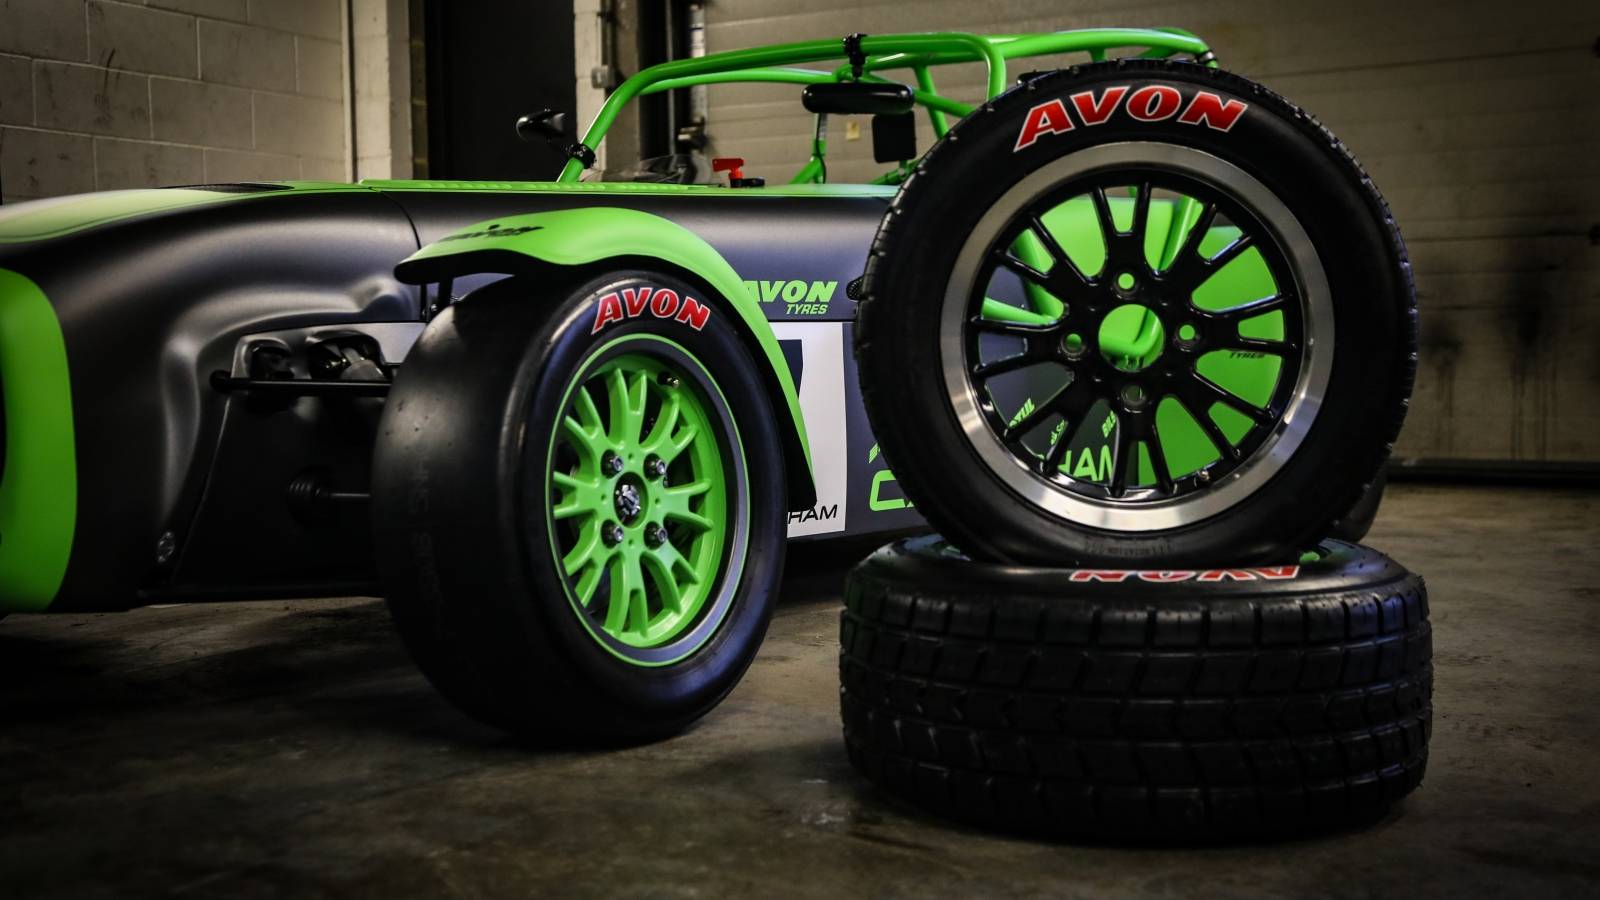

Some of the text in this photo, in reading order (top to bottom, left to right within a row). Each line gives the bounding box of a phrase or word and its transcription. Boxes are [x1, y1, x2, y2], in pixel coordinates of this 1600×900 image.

[1013, 85, 1248, 152] AVON
[591, 287, 712, 335] AVON
[785, 303, 828, 315] TYRES
